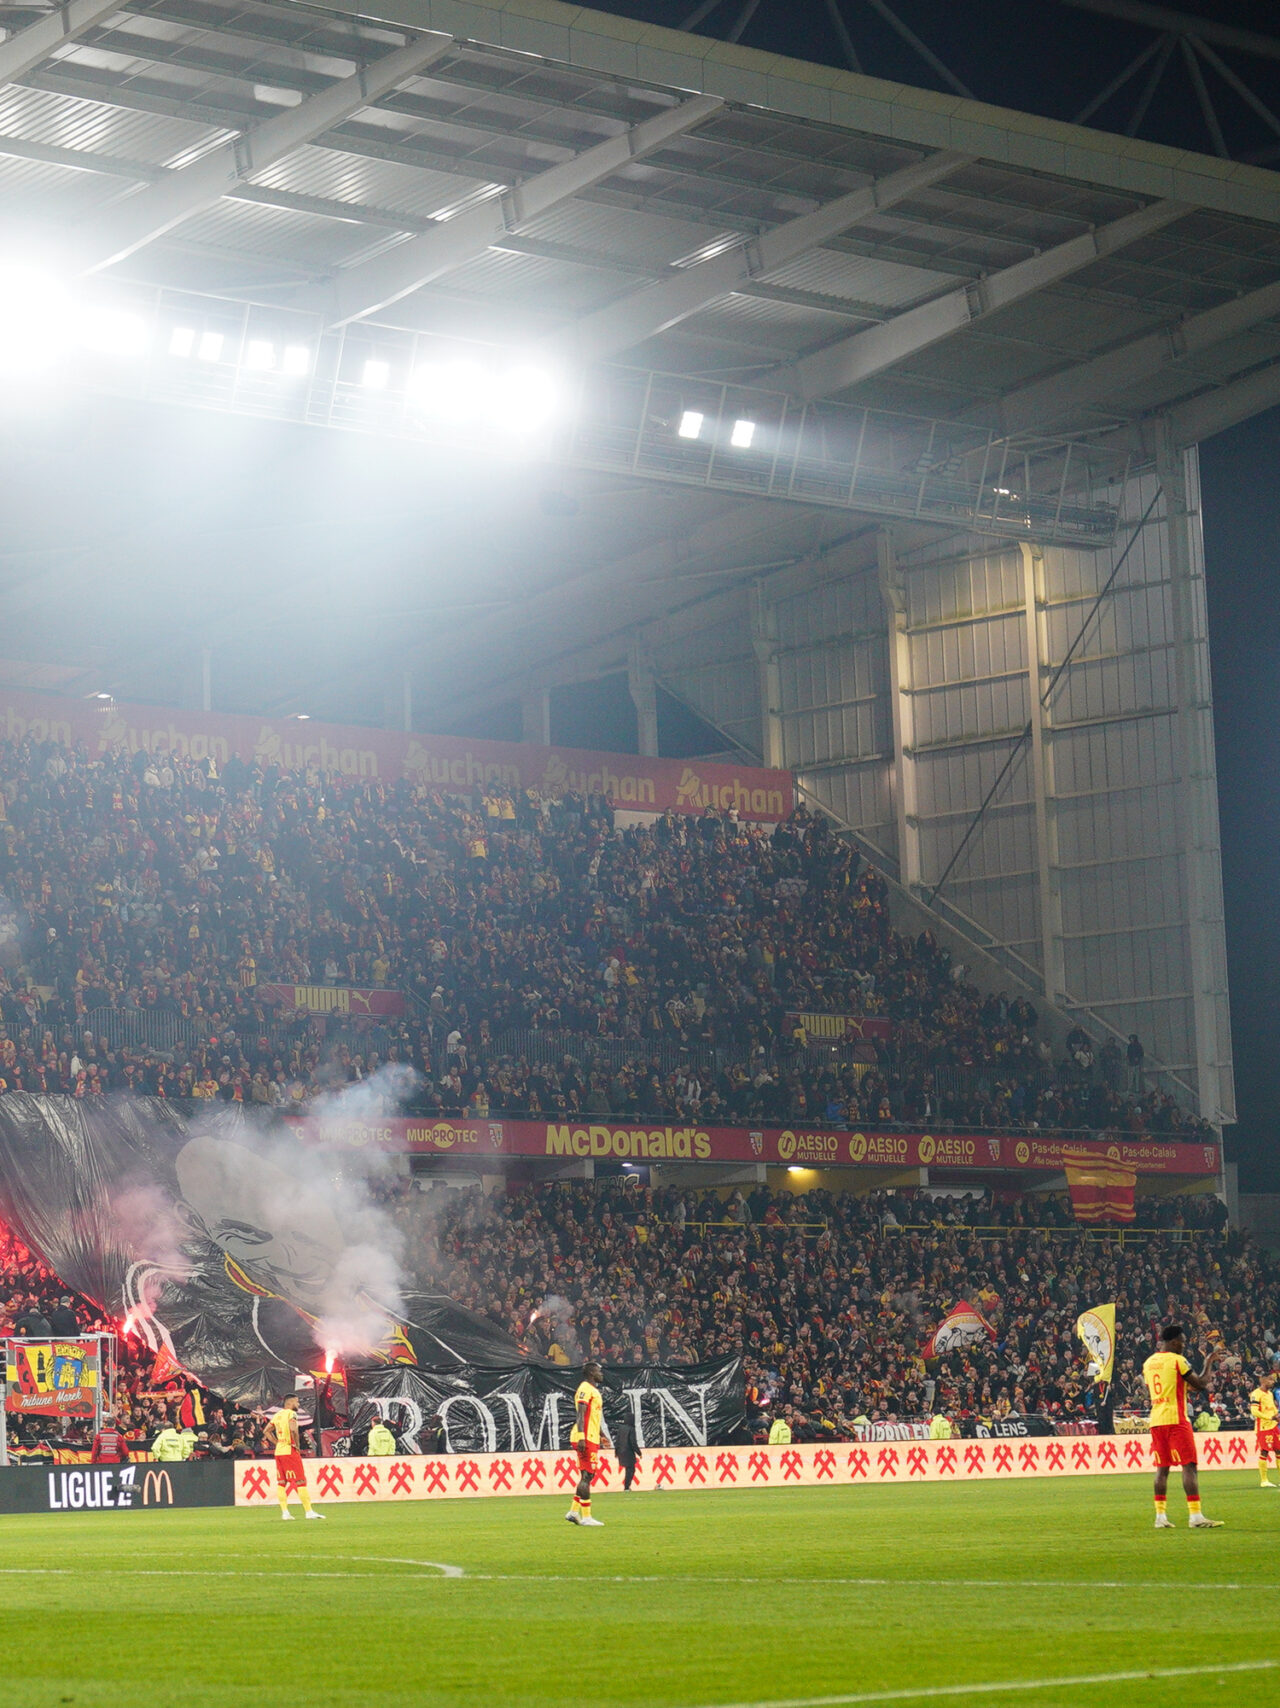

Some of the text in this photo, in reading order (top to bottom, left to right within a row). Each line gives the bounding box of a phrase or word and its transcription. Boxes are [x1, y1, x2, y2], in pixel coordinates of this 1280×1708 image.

[675, 766, 783, 815] Auchan
[295, 986, 349, 1012] PUMA
[407, 1127, 478, 1143] MURPROTEC
[545, 1125, 712, 1158] McDonald's
[797, 1152, 836, 1161] MUTUELLE
[868, 1154, 906, 1163] MUTUELLE
[936, 1155, 974, 1165] MUTUELLE
[1153, 1374, 1163, 1395] 6
[20, 1389, 83, 1408] Tribune Marek
[368, 1384, 711, 1455] ROMIN
[994, 1422, 1028, 1437] LENS
[48, 1471, 115, 1509] LIGUE
